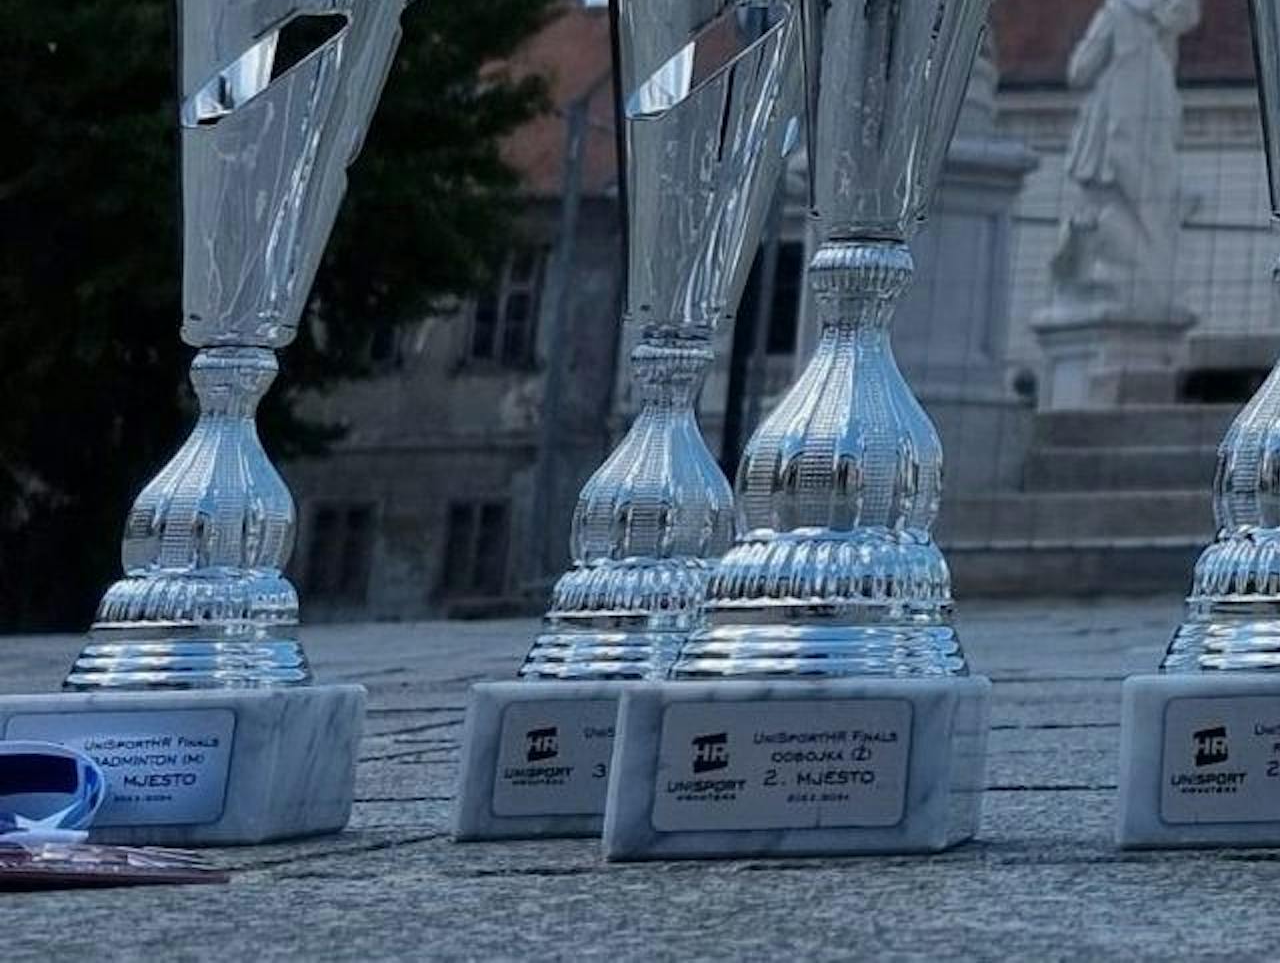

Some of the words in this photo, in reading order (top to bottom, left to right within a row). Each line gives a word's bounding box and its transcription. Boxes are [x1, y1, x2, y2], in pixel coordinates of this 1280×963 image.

[124, 773, 196, 787] MJESTO
[763, 770, 785, 786] 2.
[797, 771, 875, 785] MJESTO
[1171, 773, 1248, 786] UNISPORT
